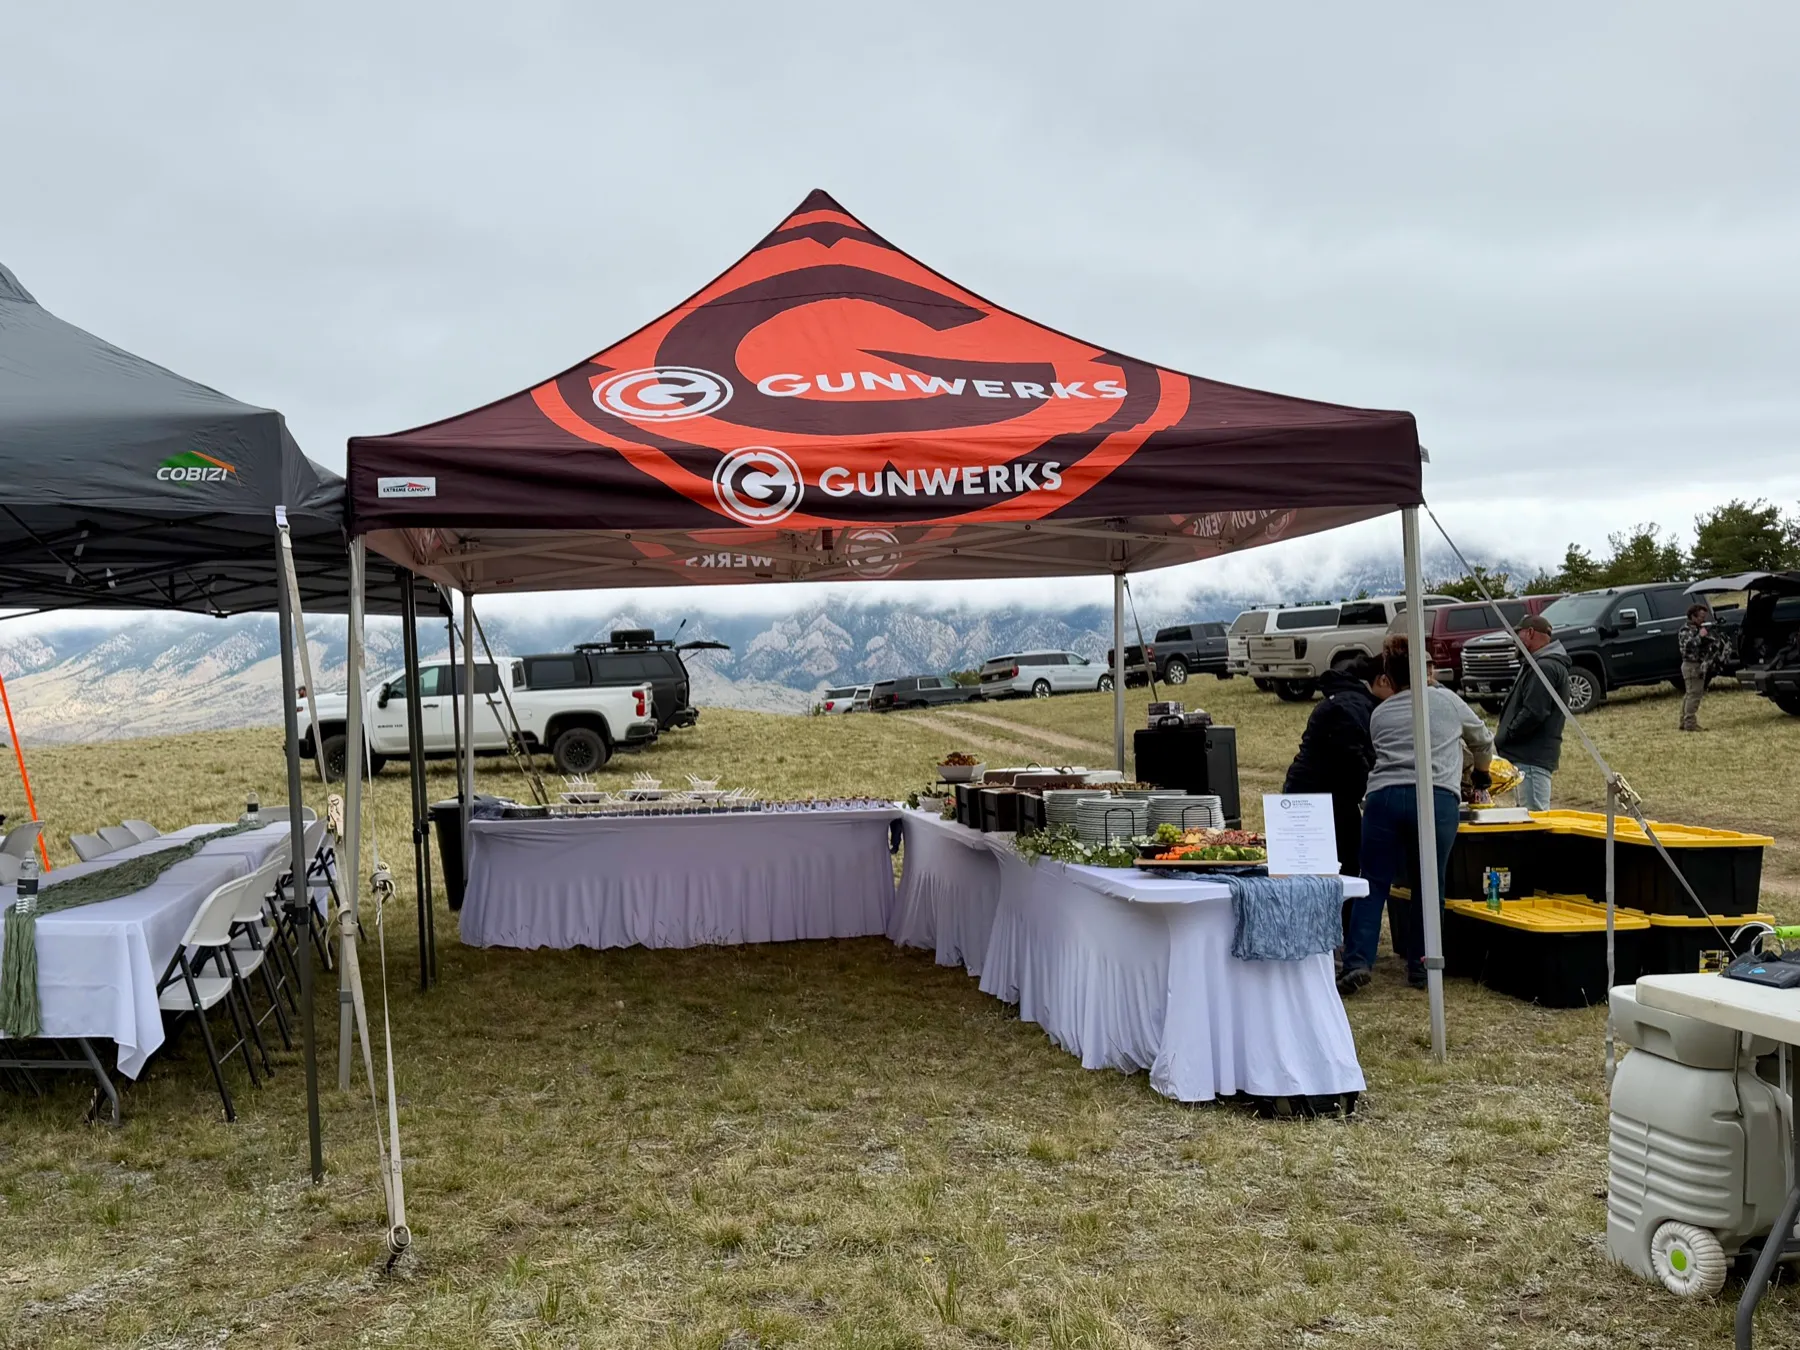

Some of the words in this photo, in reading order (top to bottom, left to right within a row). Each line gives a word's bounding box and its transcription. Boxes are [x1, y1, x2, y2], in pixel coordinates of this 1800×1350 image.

[757, 371, 1128, 399] GUNWERKS
[156, 466, 228, 481] COBIZI
[819, 461, 1063, 497] GUNWERKS
